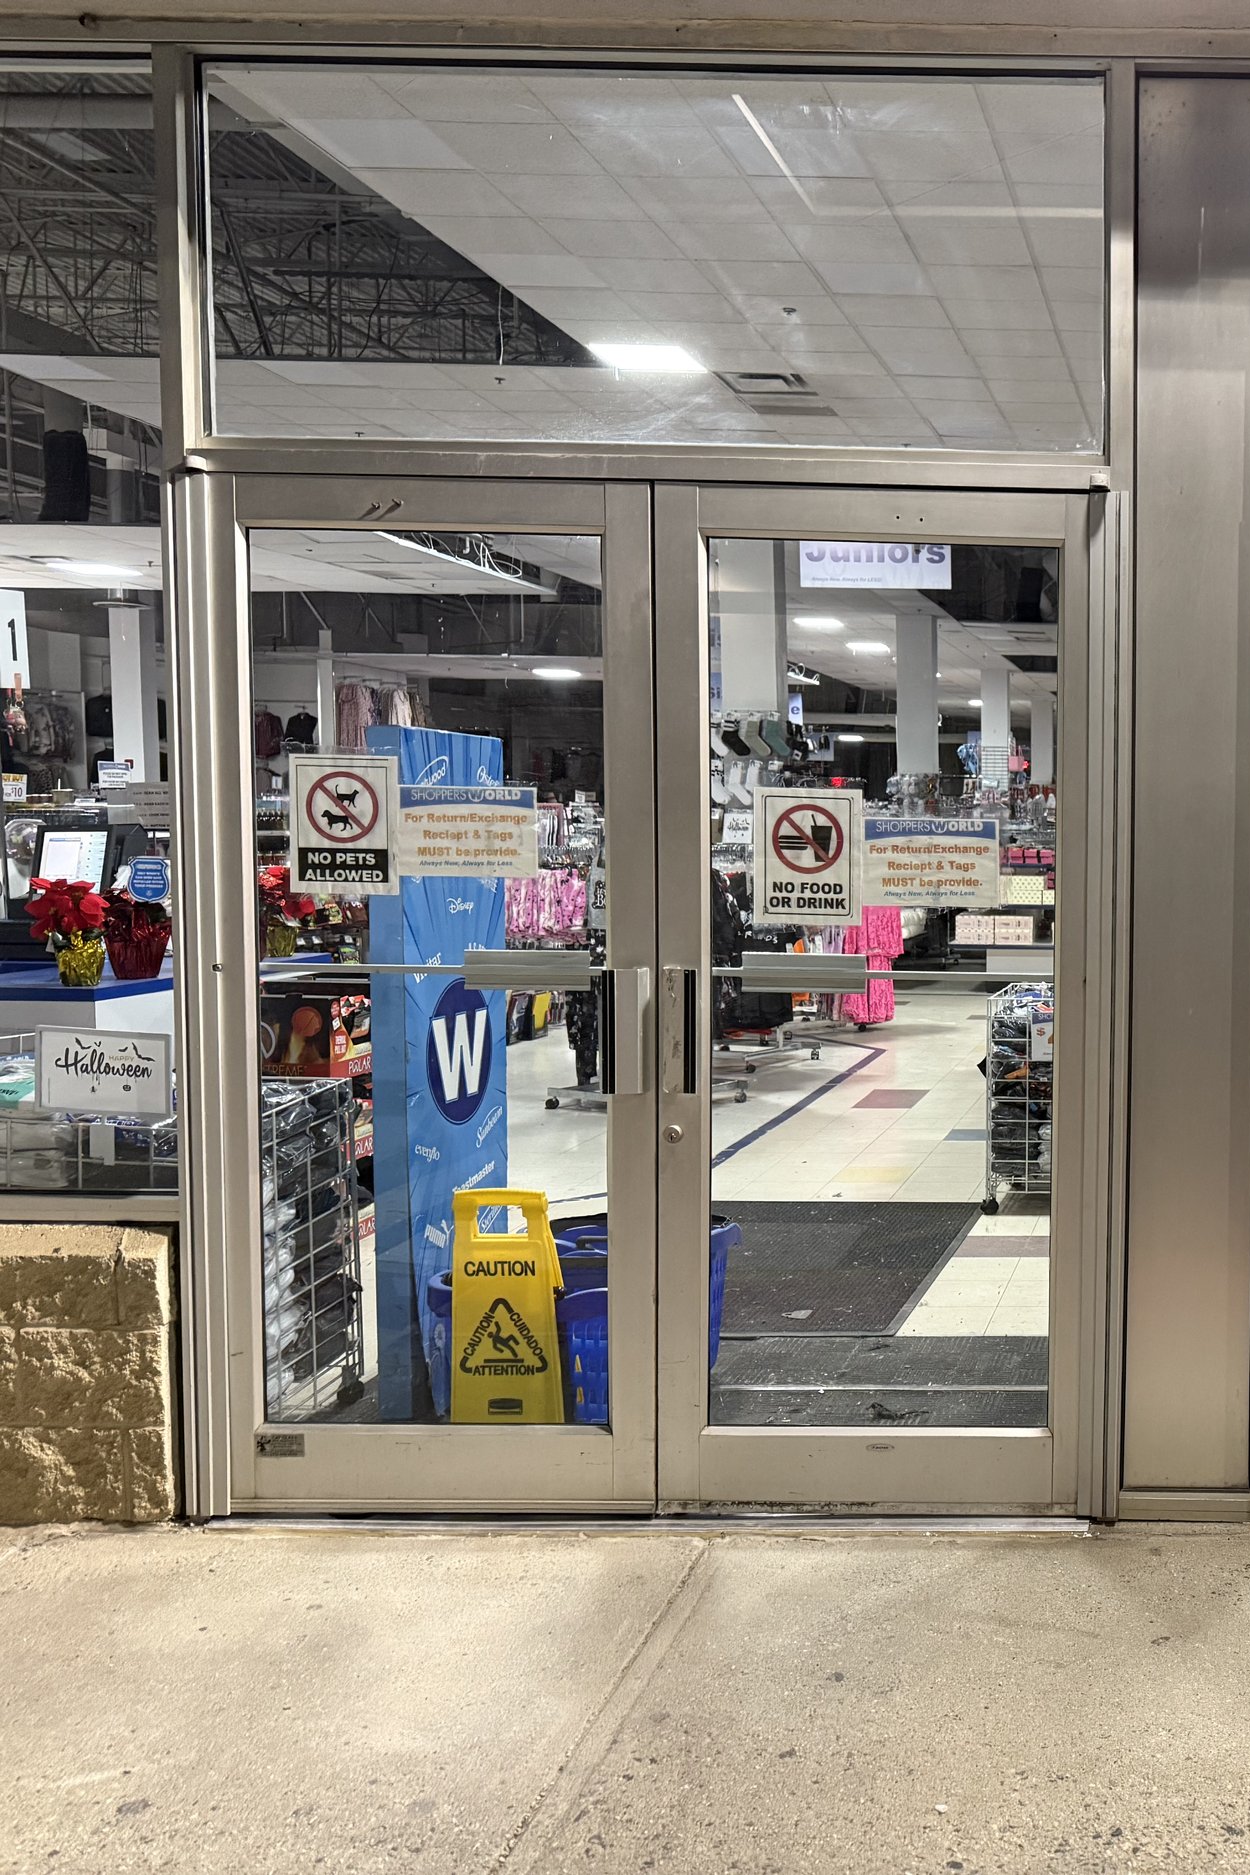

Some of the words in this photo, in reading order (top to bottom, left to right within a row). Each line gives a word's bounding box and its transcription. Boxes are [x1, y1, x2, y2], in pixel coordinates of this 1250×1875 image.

[805, 544, 946, 564] Juniors
[404, 813, 424, 824] For
[427, 813, 527, 825] Return/Exchange
[472, 830, 482, 840] &
[485, 830, 514, 843] Tags
[417, 846, 453, 857] MUST
[455, 846, 469, 857] be
[869, 845, 890, 855] For
[891, 845, 990, 857] Return/Exchange
[307, 852, 333, 865] NO
[336, 852, 376, 866] PETS
[936, 861, 945, 871] &
[948, 861, 976, 874] Tags
[304, 870, 384, 882] ALLOWED
[773, 882, 795, 894] NO
[800, 882, 843, 895] FOOD
[882, 878, 916, 888] MUST
[919, 878, 934, 888] be
[937, 878, 983, 889] provide.
[769, 896, 792, 909] OR
[796, 897, 847, 910] DRINK
[54, 1047, 153, 1079] Halloween
[431, 1009, 488, 1104] W
[464, 1261, 536, 1277] CAUTION
[463, 1312, 495, 1357] CAUTION
[510, 1311, 543, 1357] CUIDADO
[472, 1364, 535, 1376] ATTENTION
